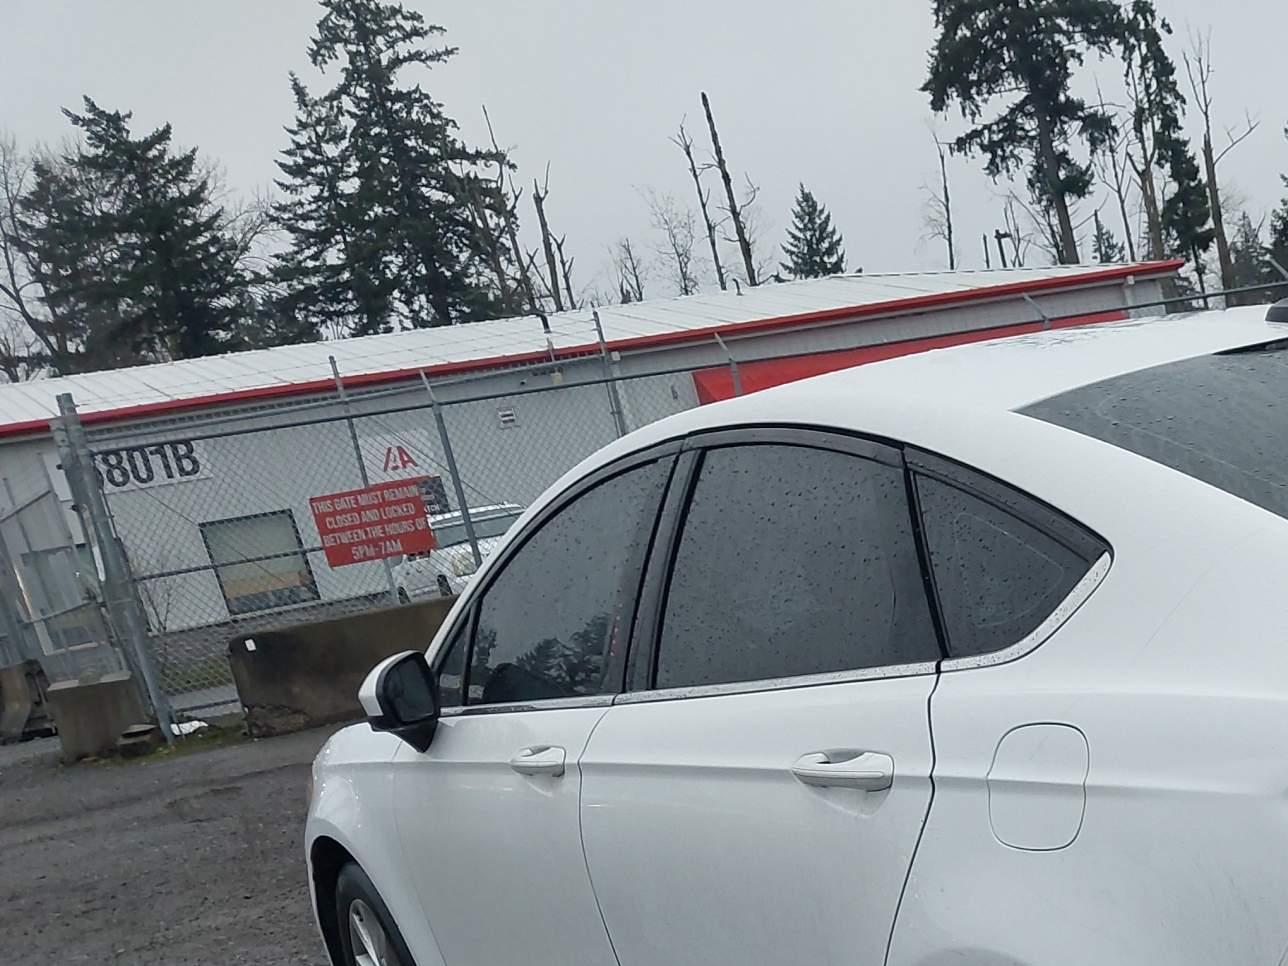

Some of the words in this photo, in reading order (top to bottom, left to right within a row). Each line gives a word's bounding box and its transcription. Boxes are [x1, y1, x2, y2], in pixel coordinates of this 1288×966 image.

[94, 439, 200, 487] 801B
[312, 501, 333, 514] THIS
[334, 496, 357, 510] GATE
[358, 491, 382, 506] MUST
[383, 485, 419, 501] REMAIN
[325, 512, 360, 529] CLOSED
[360, 508, 379, 522] AND
[381, 502, 416, 519] LOCKED
[322, 527, 366, 546] BETWEEN
[366, 524, 384, 538] THE
[384, 519, 414, 536] HOURS
[415, 517, 428, 530] OF
[351, 538, 403, 560] 5PM-7AM
